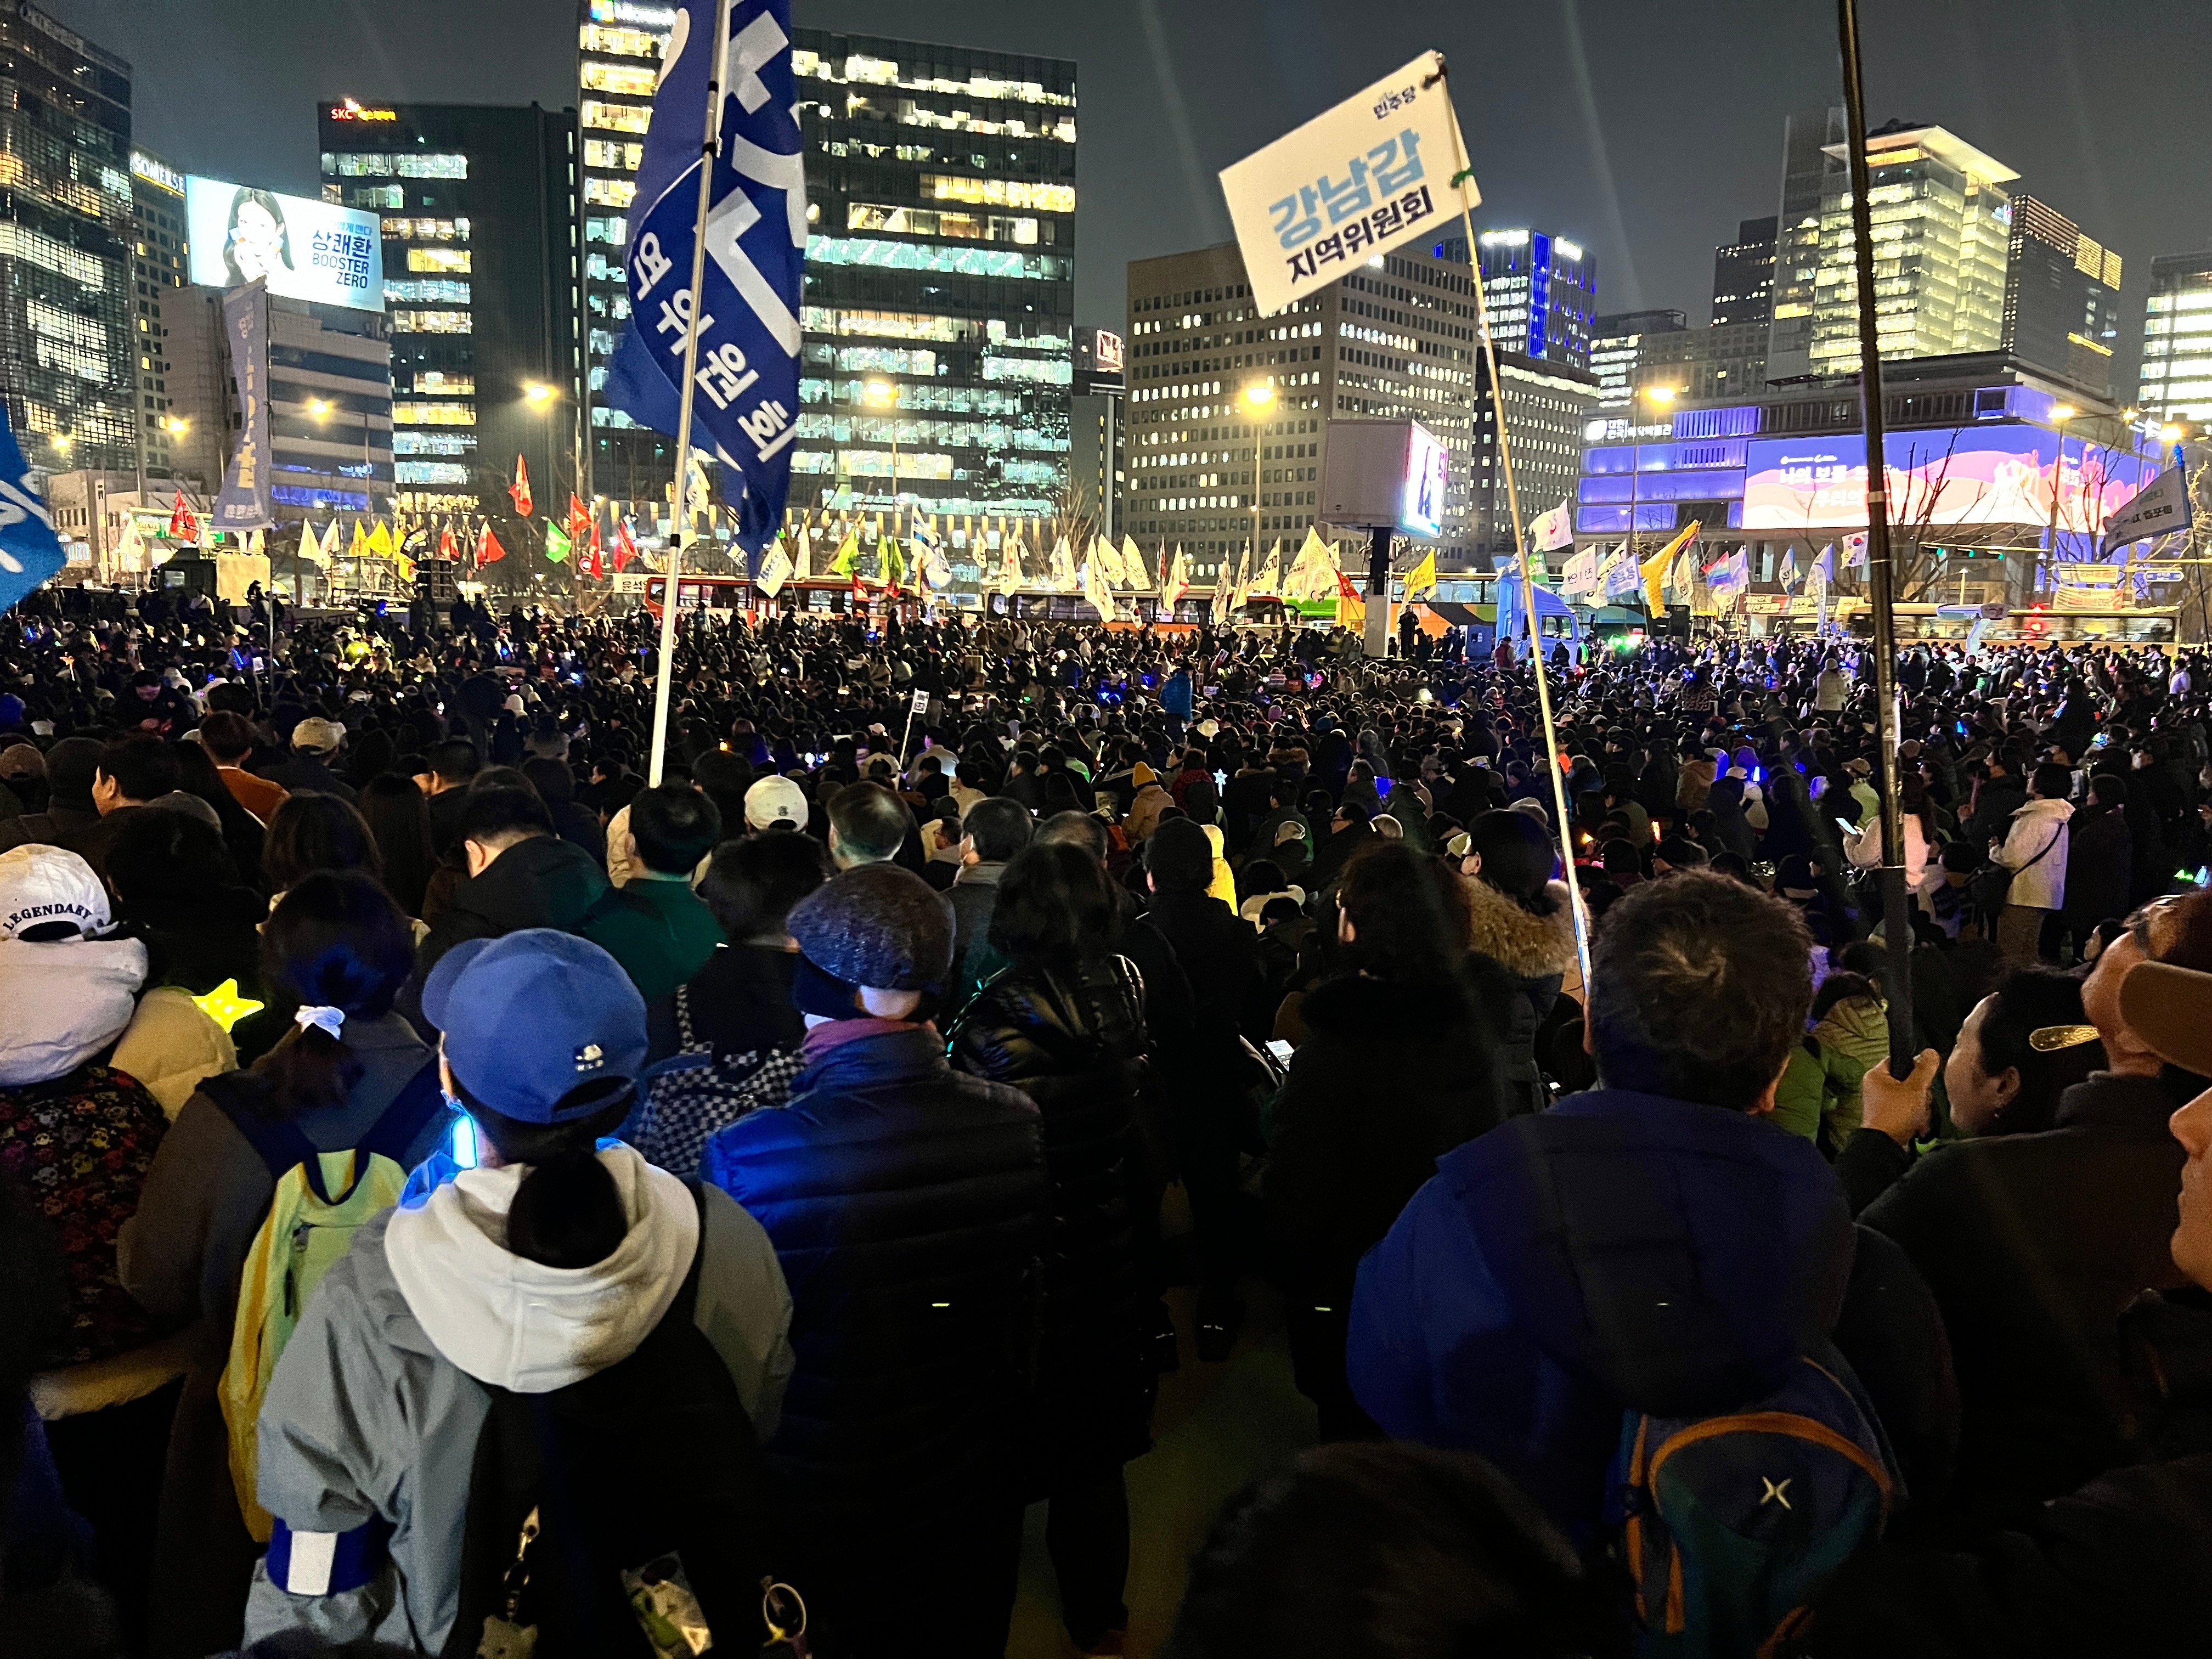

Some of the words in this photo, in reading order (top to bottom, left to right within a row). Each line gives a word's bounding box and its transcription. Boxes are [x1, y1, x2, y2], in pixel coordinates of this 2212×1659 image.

[331, 108, 354, 120] SKC
[1373, 85, 1416, 120] 민주당
[313, 230, 372, 260] 상쾌환
[1286, 184, 1434, 284] 지역위원회
[313, 252, 370, 275] BOOSTER
[336, 272, 368, 289] ZERO
[3, 904, 93, 931] LEGENDARY
